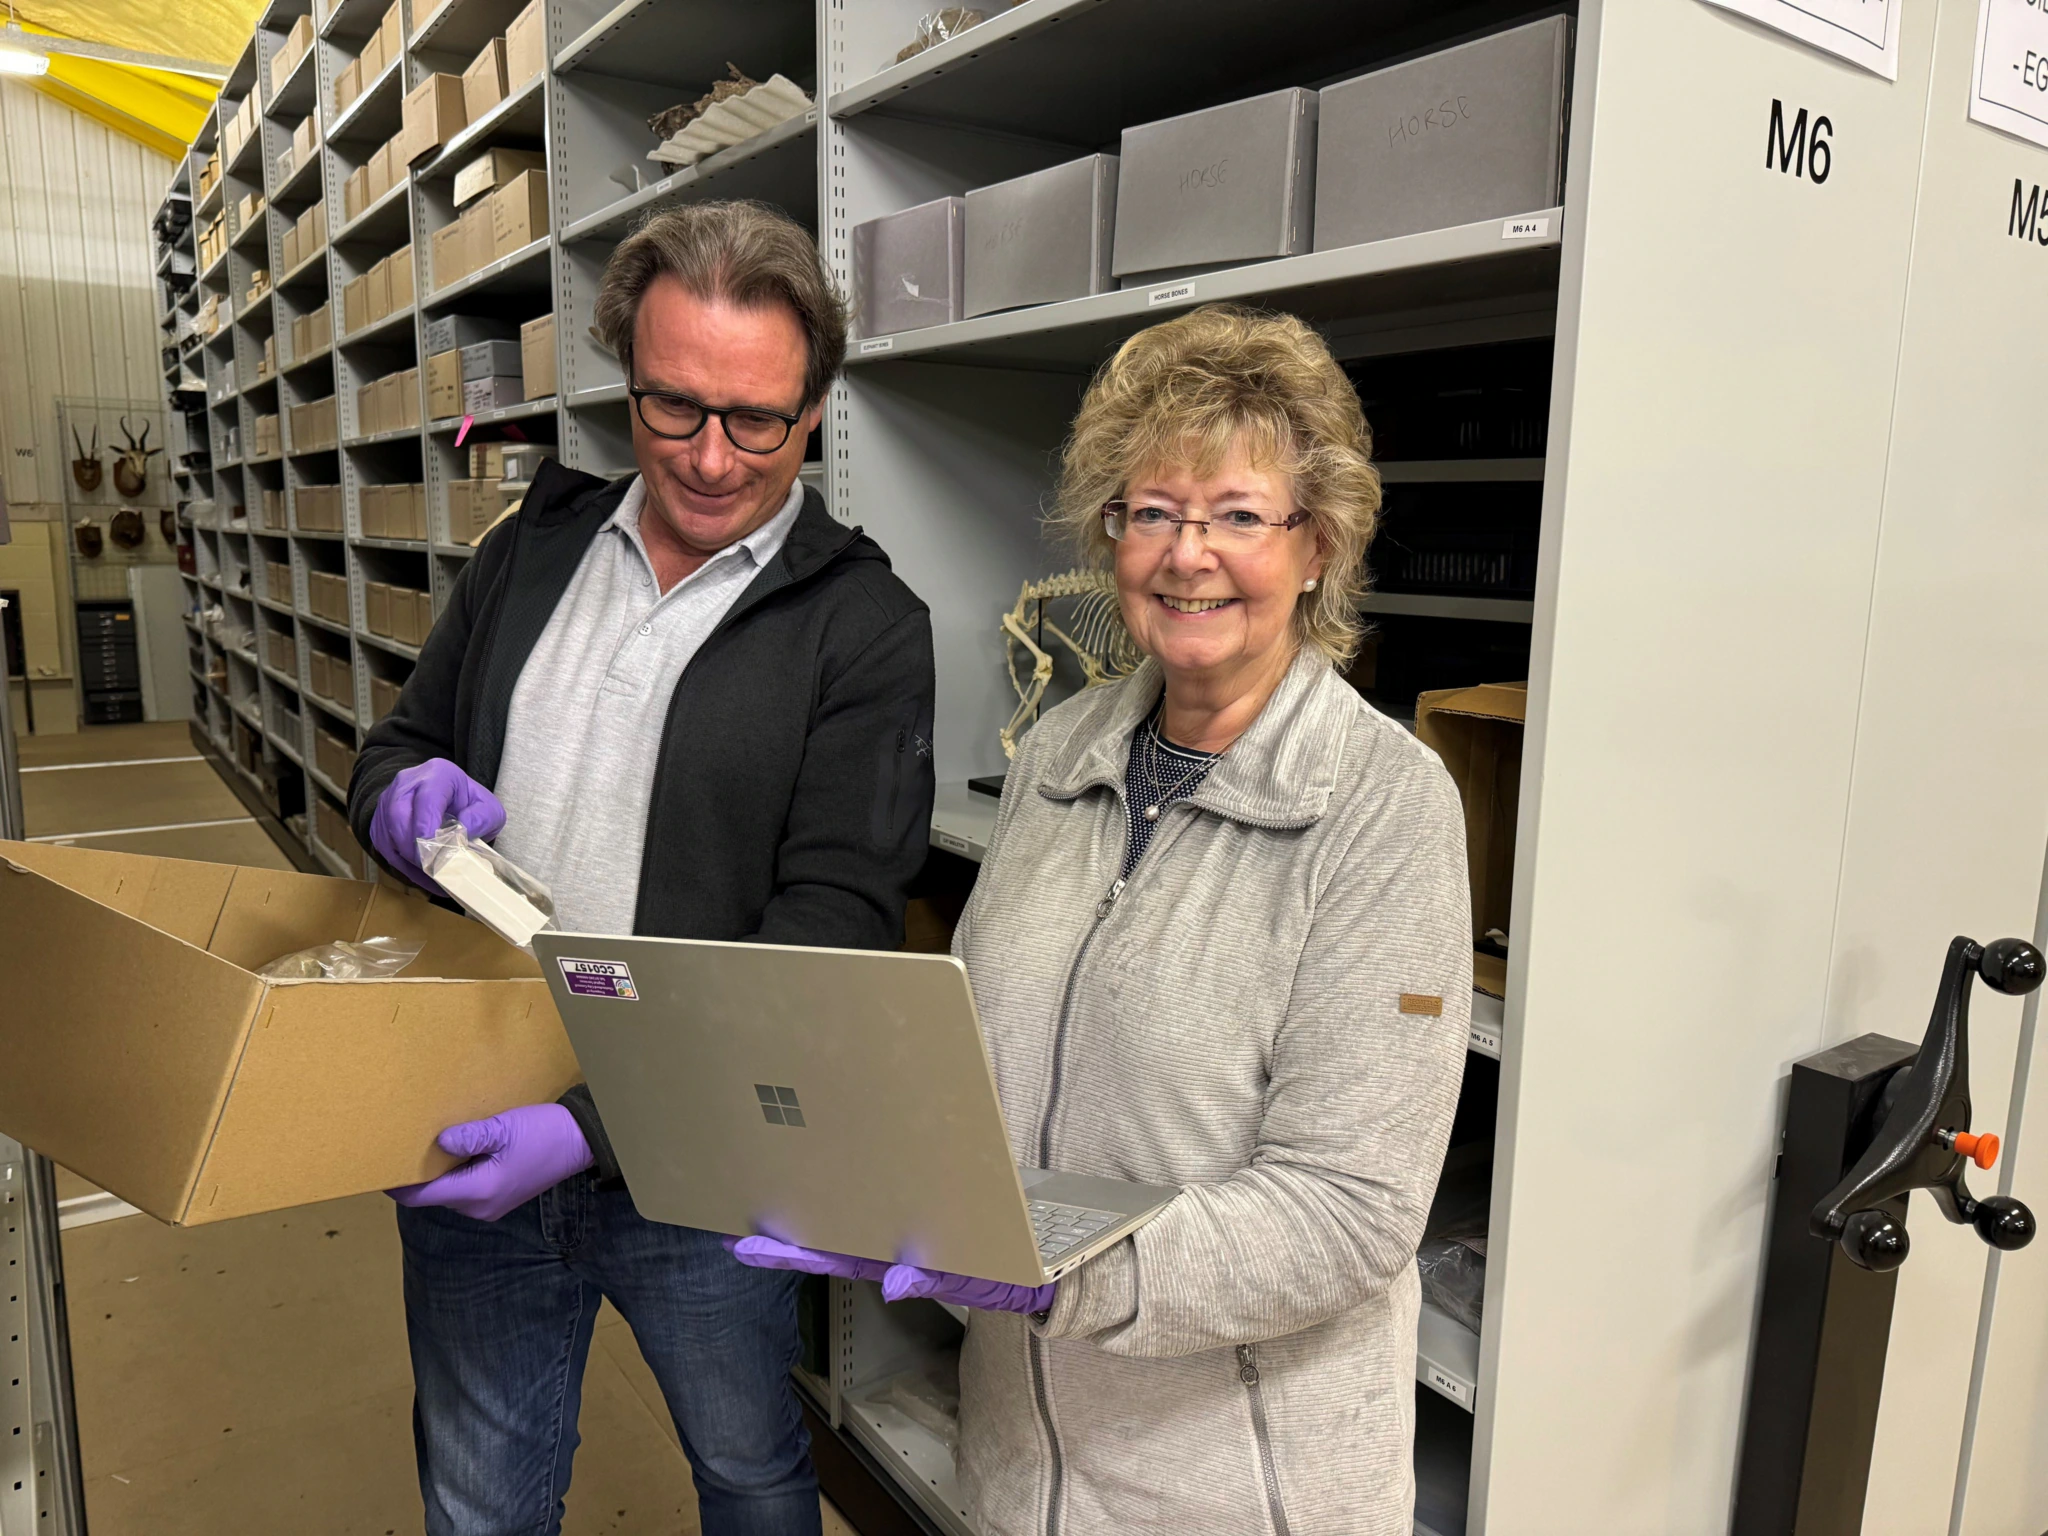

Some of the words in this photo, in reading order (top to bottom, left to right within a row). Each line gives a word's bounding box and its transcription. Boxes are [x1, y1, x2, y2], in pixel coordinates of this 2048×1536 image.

[1388, 95, 1471, 148] HORSE
[1765, 97, 1833, 184] M6
[1179, 159, 1229, 195] HORSE
[1512, 225, 1523, 233] M6
[1525, 224, 1530, 232] A
[1531, 224, 1537, 232] 4
[1154, 291, 1170, 301] HORSE
[1171, 288, 1188, 297] BONES
[575, 963, 615, 974] CC0157
[1470, 1032, 1480, 1041] M6
[1436, 1375, 1445, 1385] M6
[1446, 1382, 1451, 1390] A
